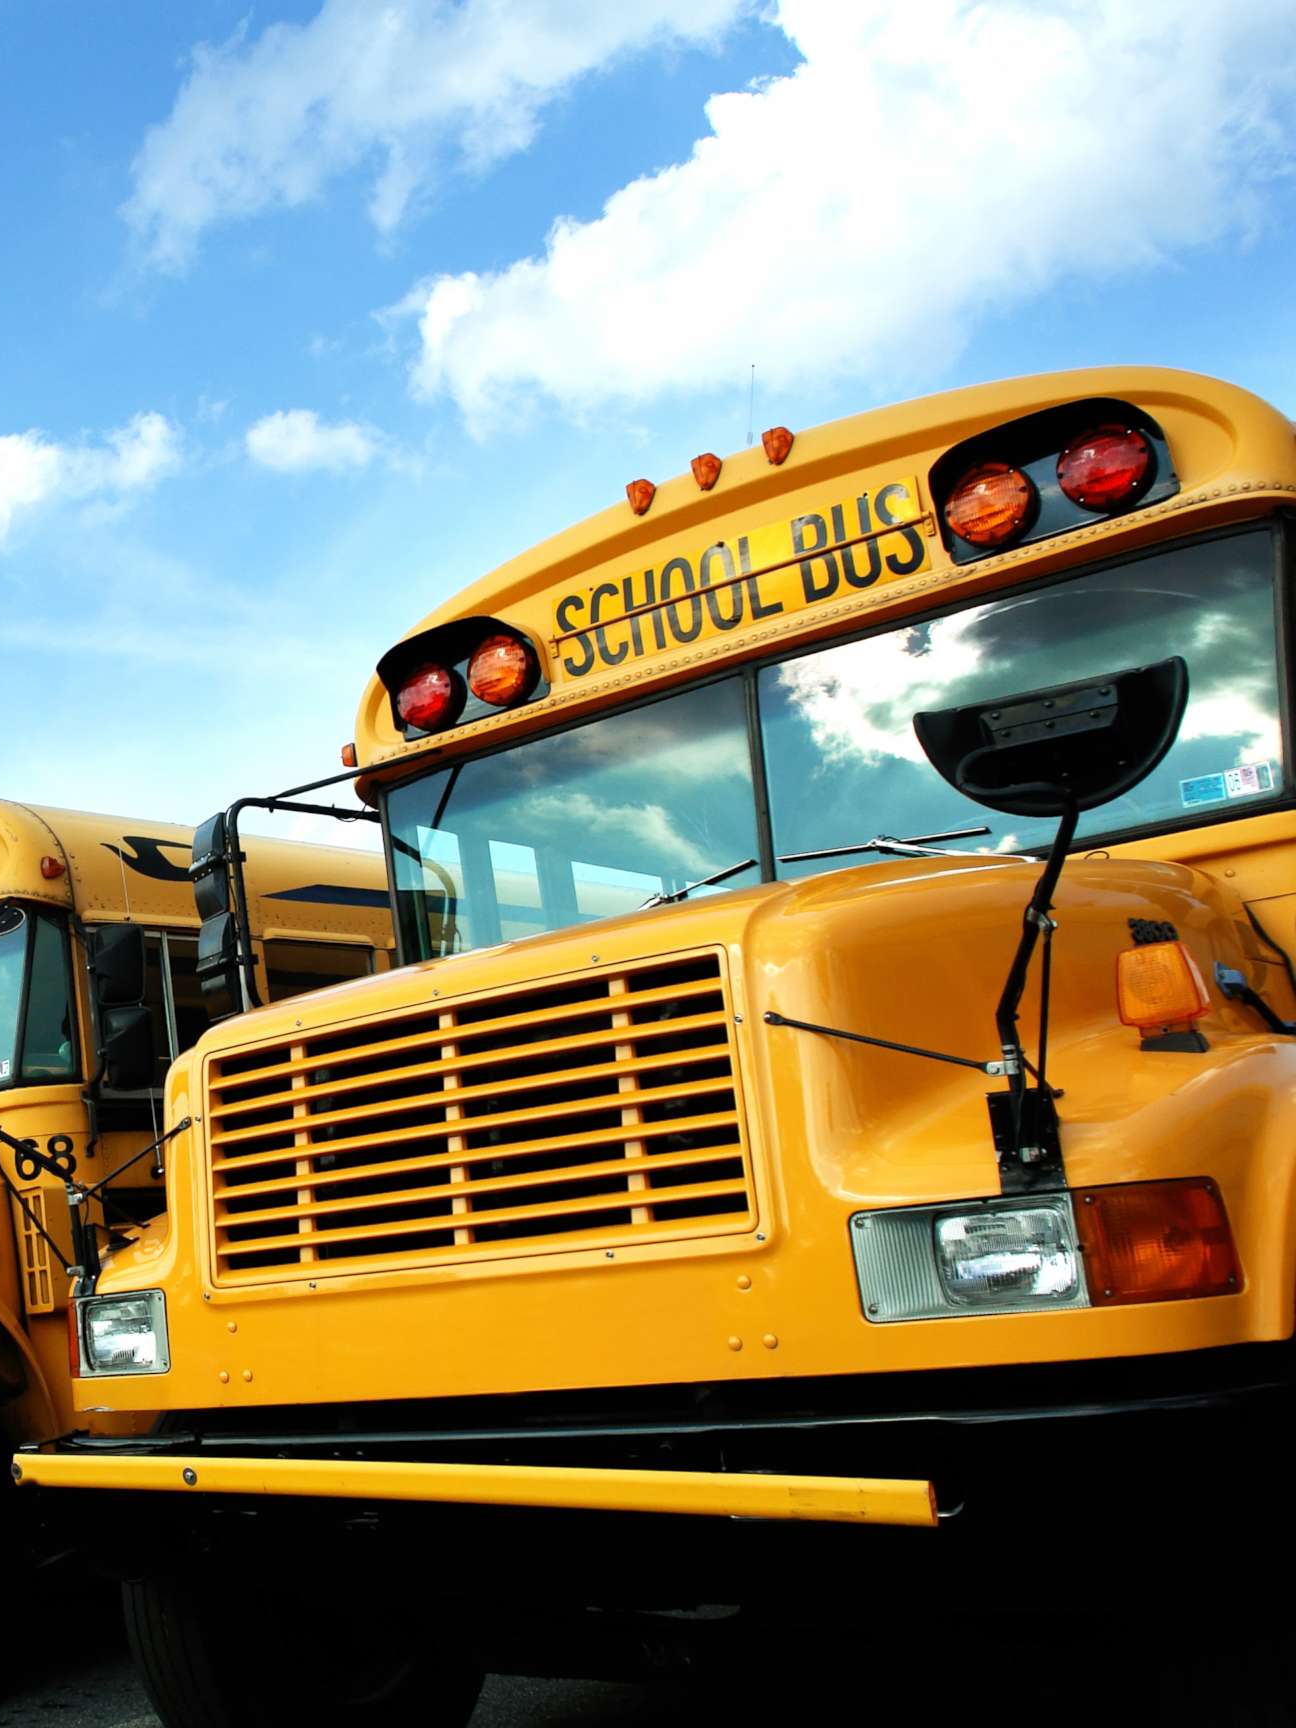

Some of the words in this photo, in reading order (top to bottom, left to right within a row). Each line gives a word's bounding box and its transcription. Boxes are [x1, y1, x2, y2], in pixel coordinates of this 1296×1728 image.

[555, 536, 783, 677] SCHOOL
[790, 483, 926, 604] BUS
[15, 1135, 77, 1181] 68
